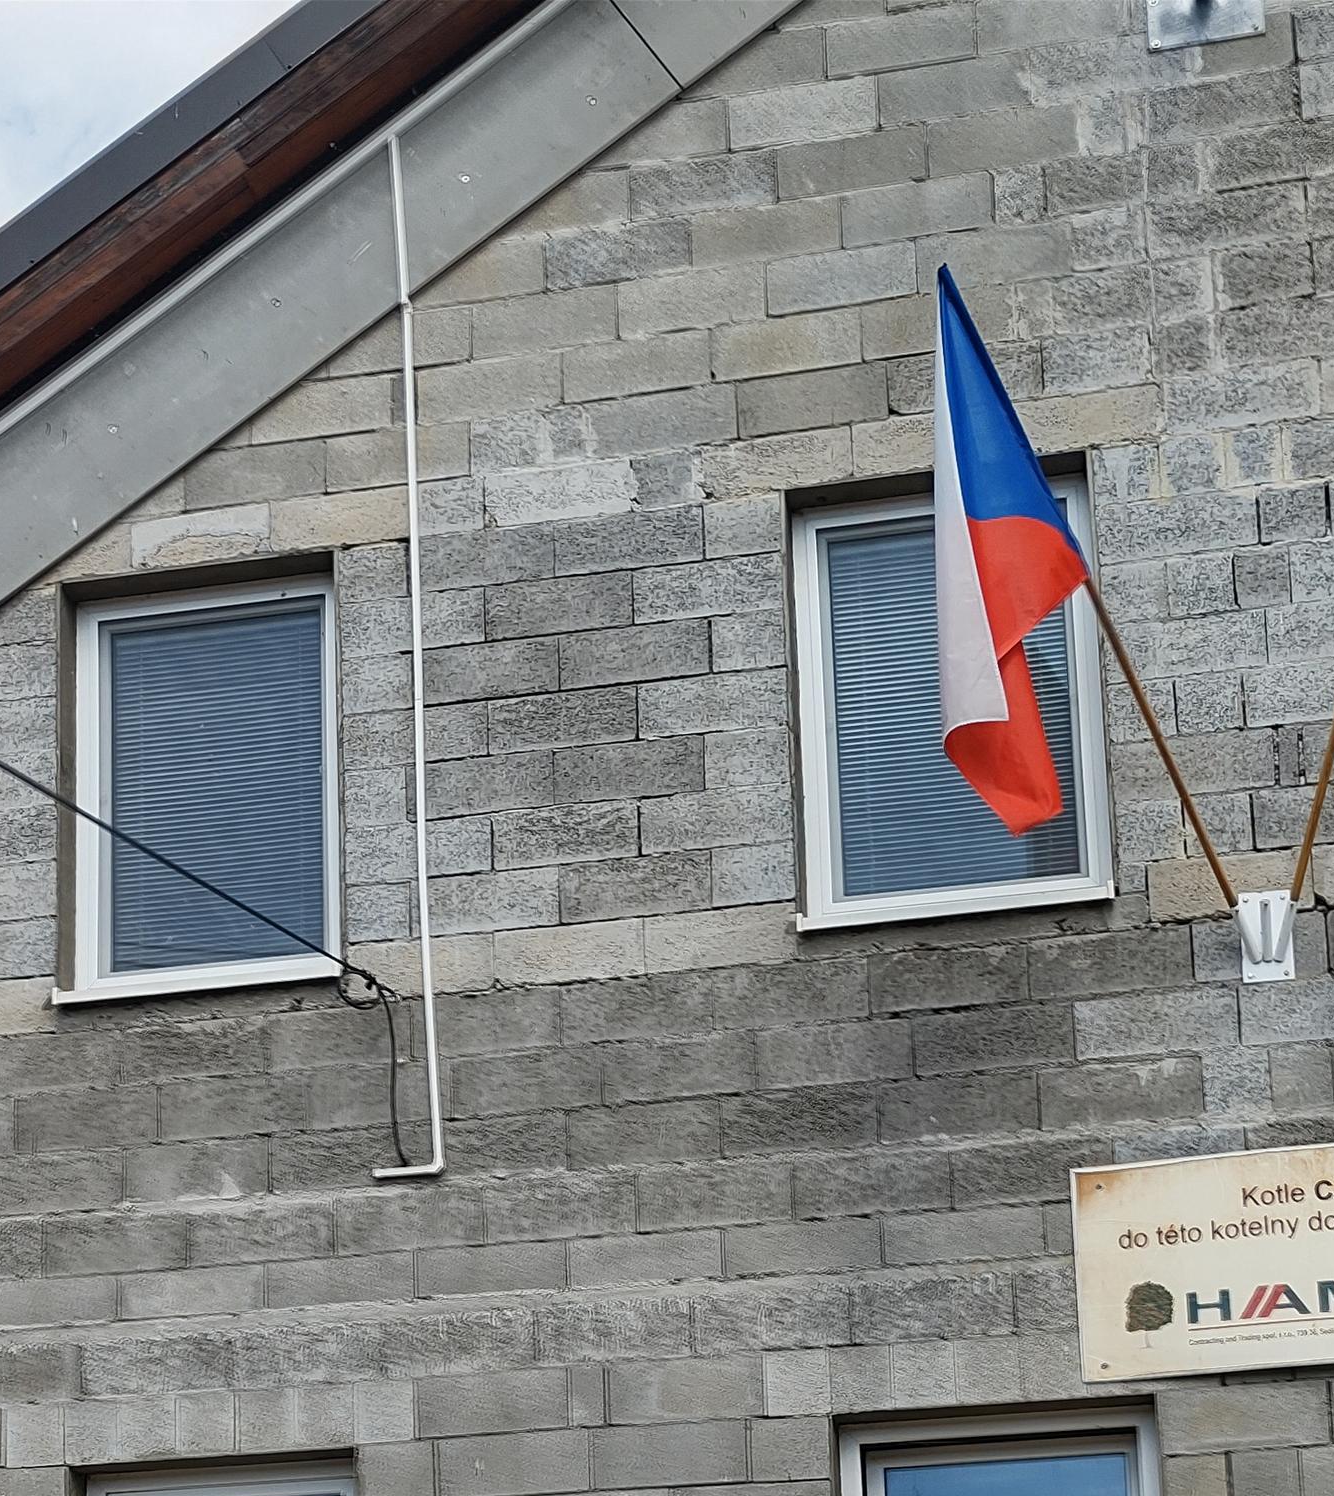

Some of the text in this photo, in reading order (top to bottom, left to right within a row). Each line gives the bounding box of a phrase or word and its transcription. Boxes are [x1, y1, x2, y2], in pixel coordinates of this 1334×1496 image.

[1242, 1184, 1305, 1207] Kotle
[1119, 1229, 1148, 1249] do
[1156, 1223, 1202, 1244] této
[1211, 1215, 1299, 1239] kotelny
